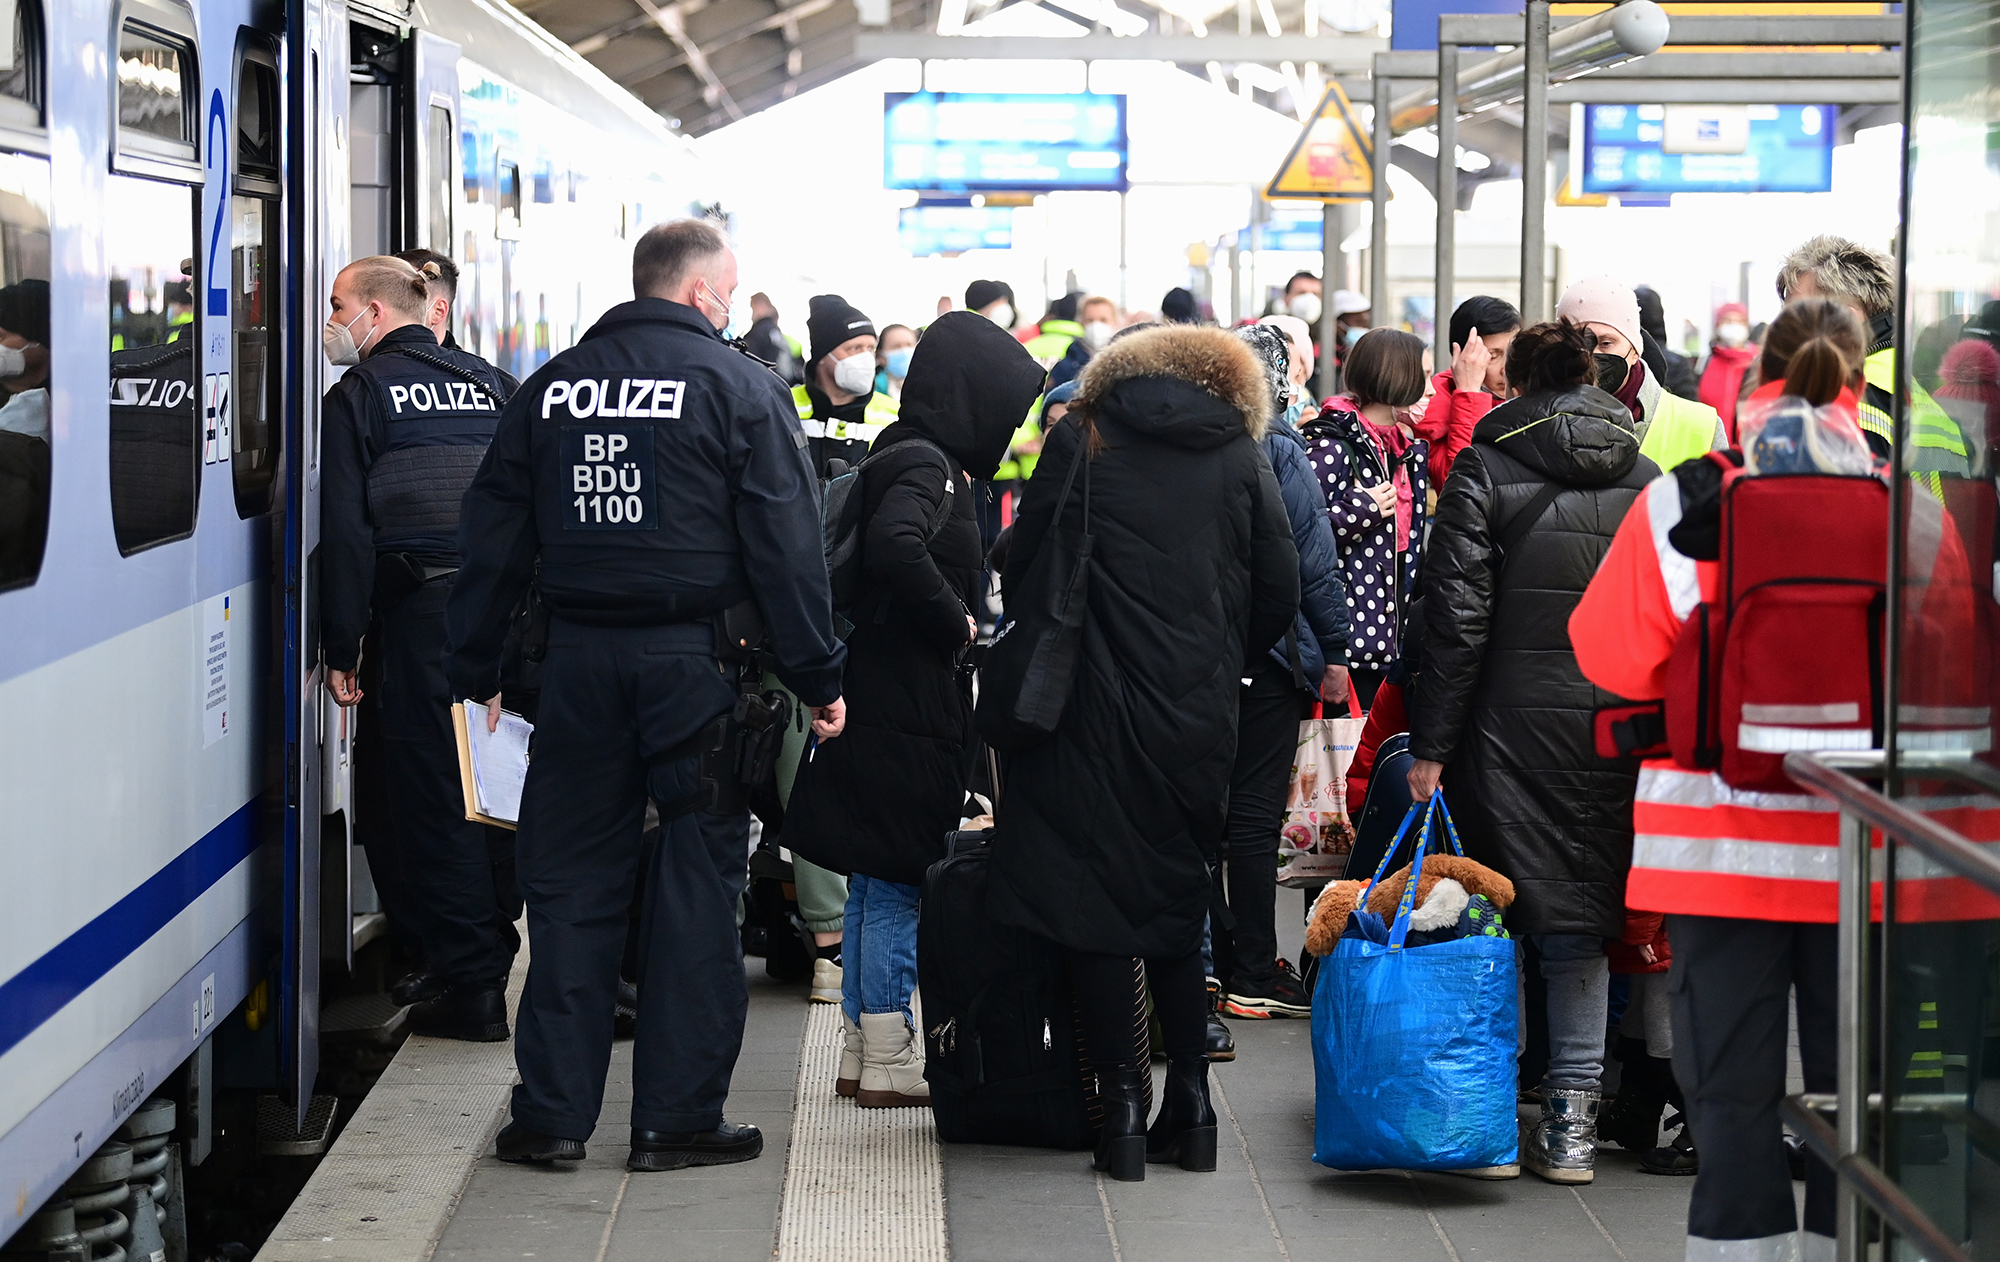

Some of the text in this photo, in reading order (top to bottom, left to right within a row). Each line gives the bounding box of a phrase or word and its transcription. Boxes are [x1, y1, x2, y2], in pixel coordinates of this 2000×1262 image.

[207, 87, 228, 317] 2
[541, 378, 687, 420] POLIZEI
[584, 433, 629, 462] BP
[572, 462, 642, 493] BDÜ
[573, 494, 644, 524] 1100
[1398, 874, 1417, 918] IKEA
